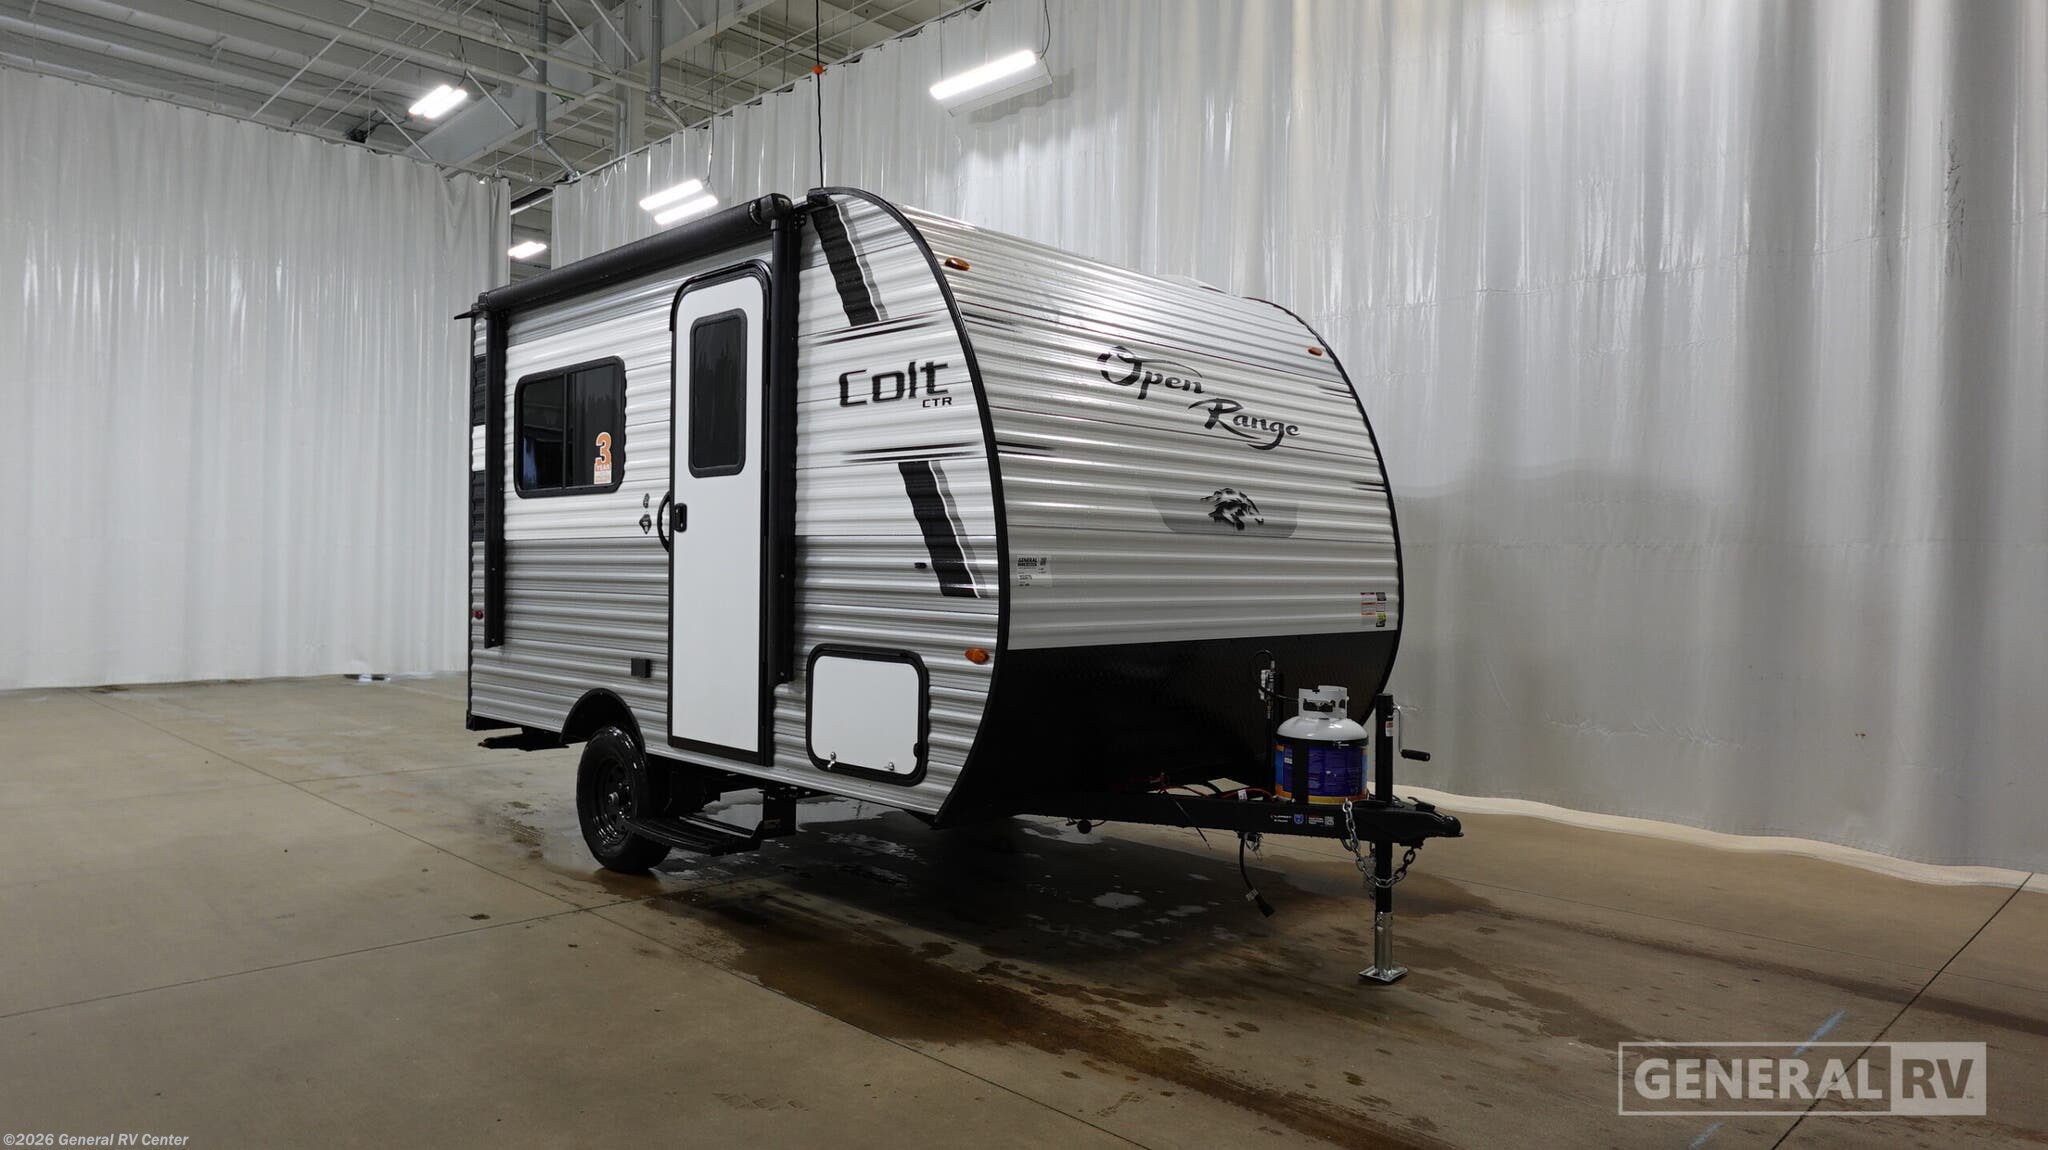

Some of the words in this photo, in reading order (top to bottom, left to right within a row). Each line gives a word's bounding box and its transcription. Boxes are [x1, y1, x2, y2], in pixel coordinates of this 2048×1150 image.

[839, 361, 949, 407] Colt
[1097, 346, 1205, 400] Open
[922, 397, 952, 408] CTR
[1188, 398, 1300, 450] Range
[595, 431, 612, 466] 3
